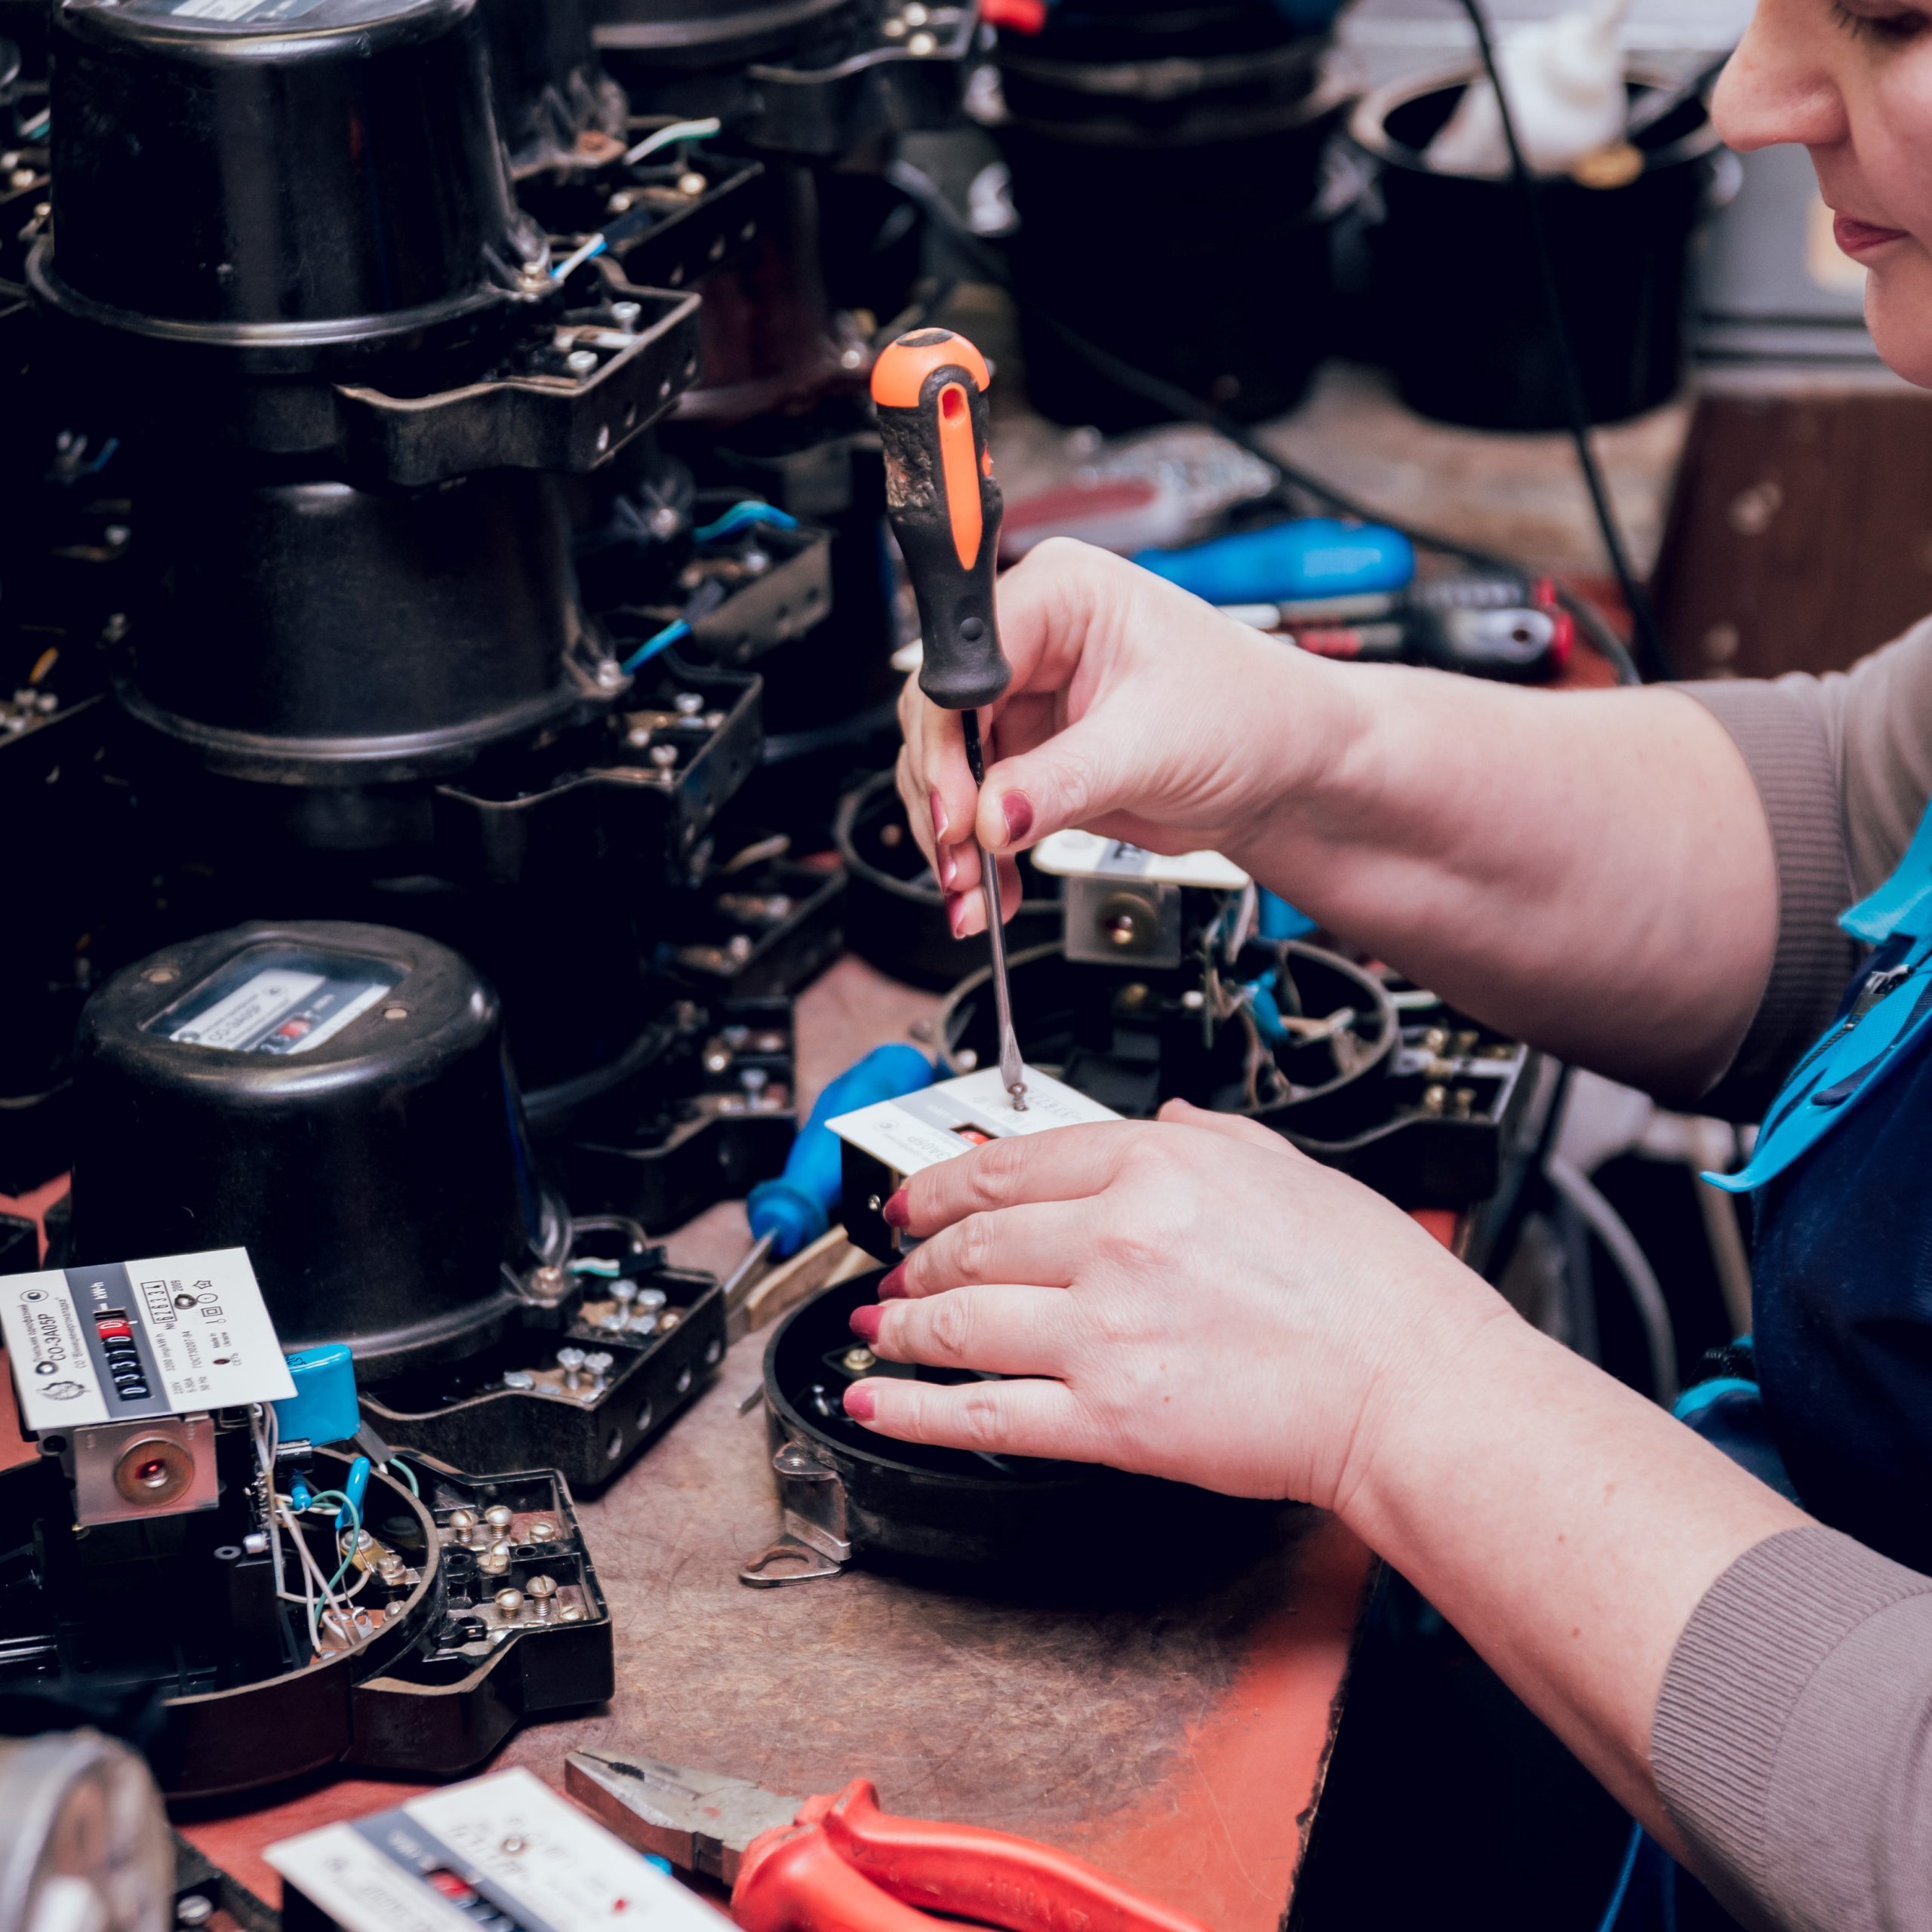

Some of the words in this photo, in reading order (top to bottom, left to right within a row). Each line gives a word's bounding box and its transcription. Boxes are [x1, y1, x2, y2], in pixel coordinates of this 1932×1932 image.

[906, 1135, 945, 1159] ЭА05Р
[171, 1280, 183, 1291] 2009
[146, 1284, 173, 1321] 626334
